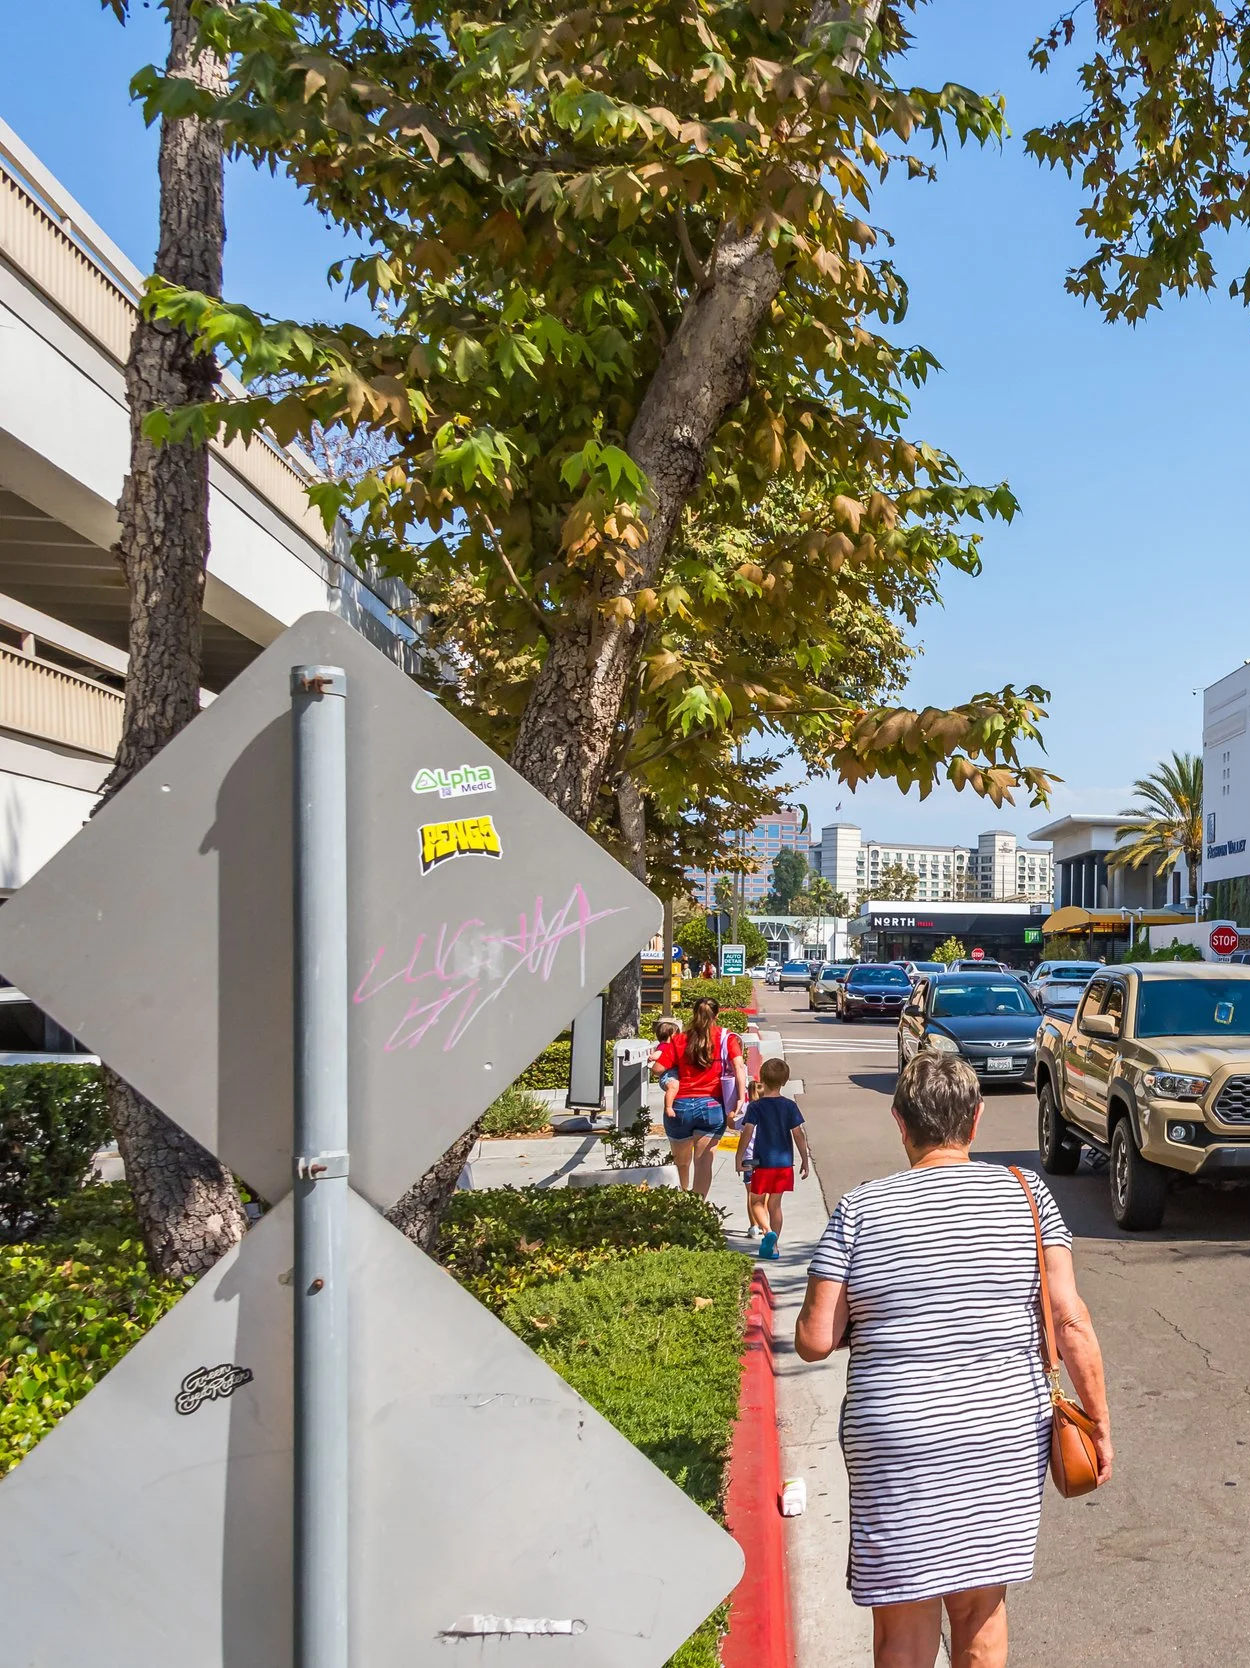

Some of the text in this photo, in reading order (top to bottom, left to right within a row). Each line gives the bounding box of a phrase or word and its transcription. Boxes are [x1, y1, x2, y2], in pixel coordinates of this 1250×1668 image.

[461, 782, 493, 793] Medic
[874, 917, 916, 927] NORTH
[1212, 935, 1237, 946] STOP
